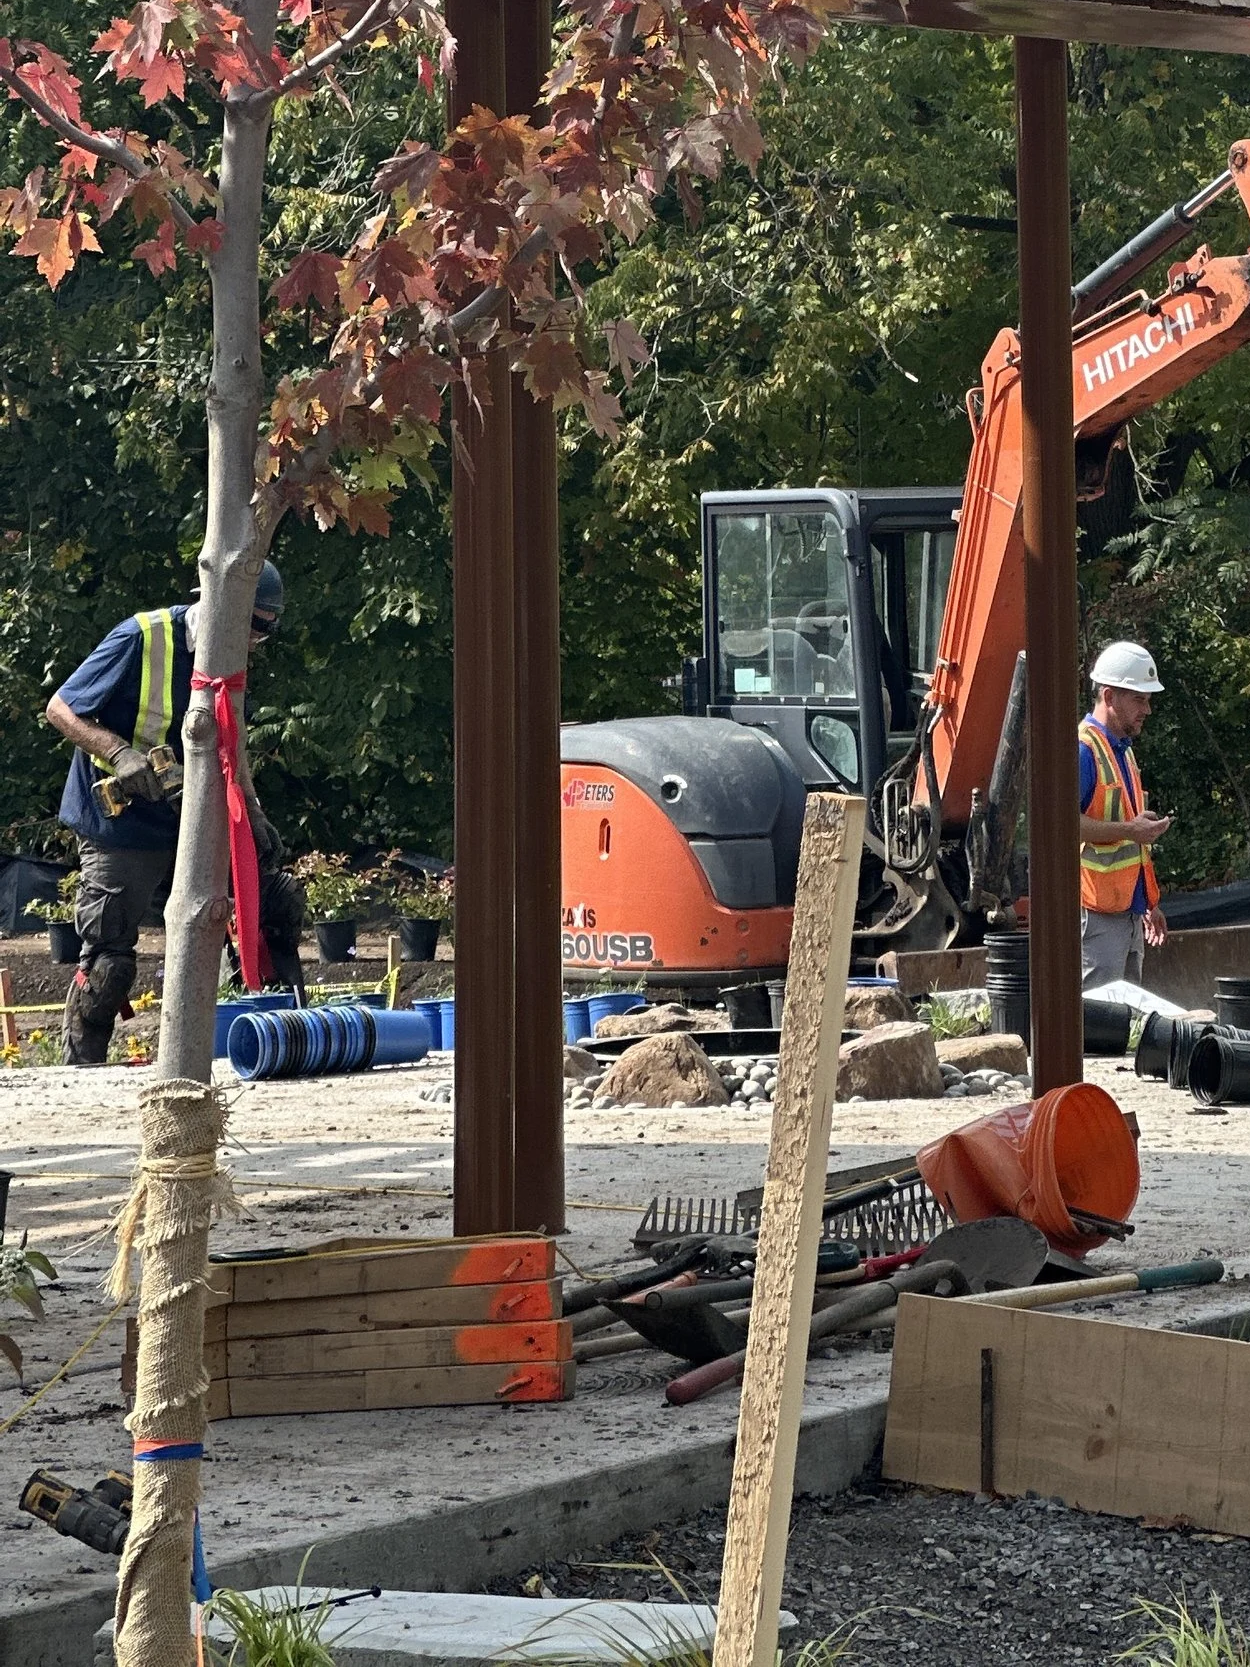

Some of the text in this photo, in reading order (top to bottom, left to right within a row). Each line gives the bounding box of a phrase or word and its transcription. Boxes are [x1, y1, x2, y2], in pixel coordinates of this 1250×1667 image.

[1082, 302, 1195, 392] HITACHI
[569, 780, 615, 807] PETERS
[562, 933, 654, 962] 60USB
